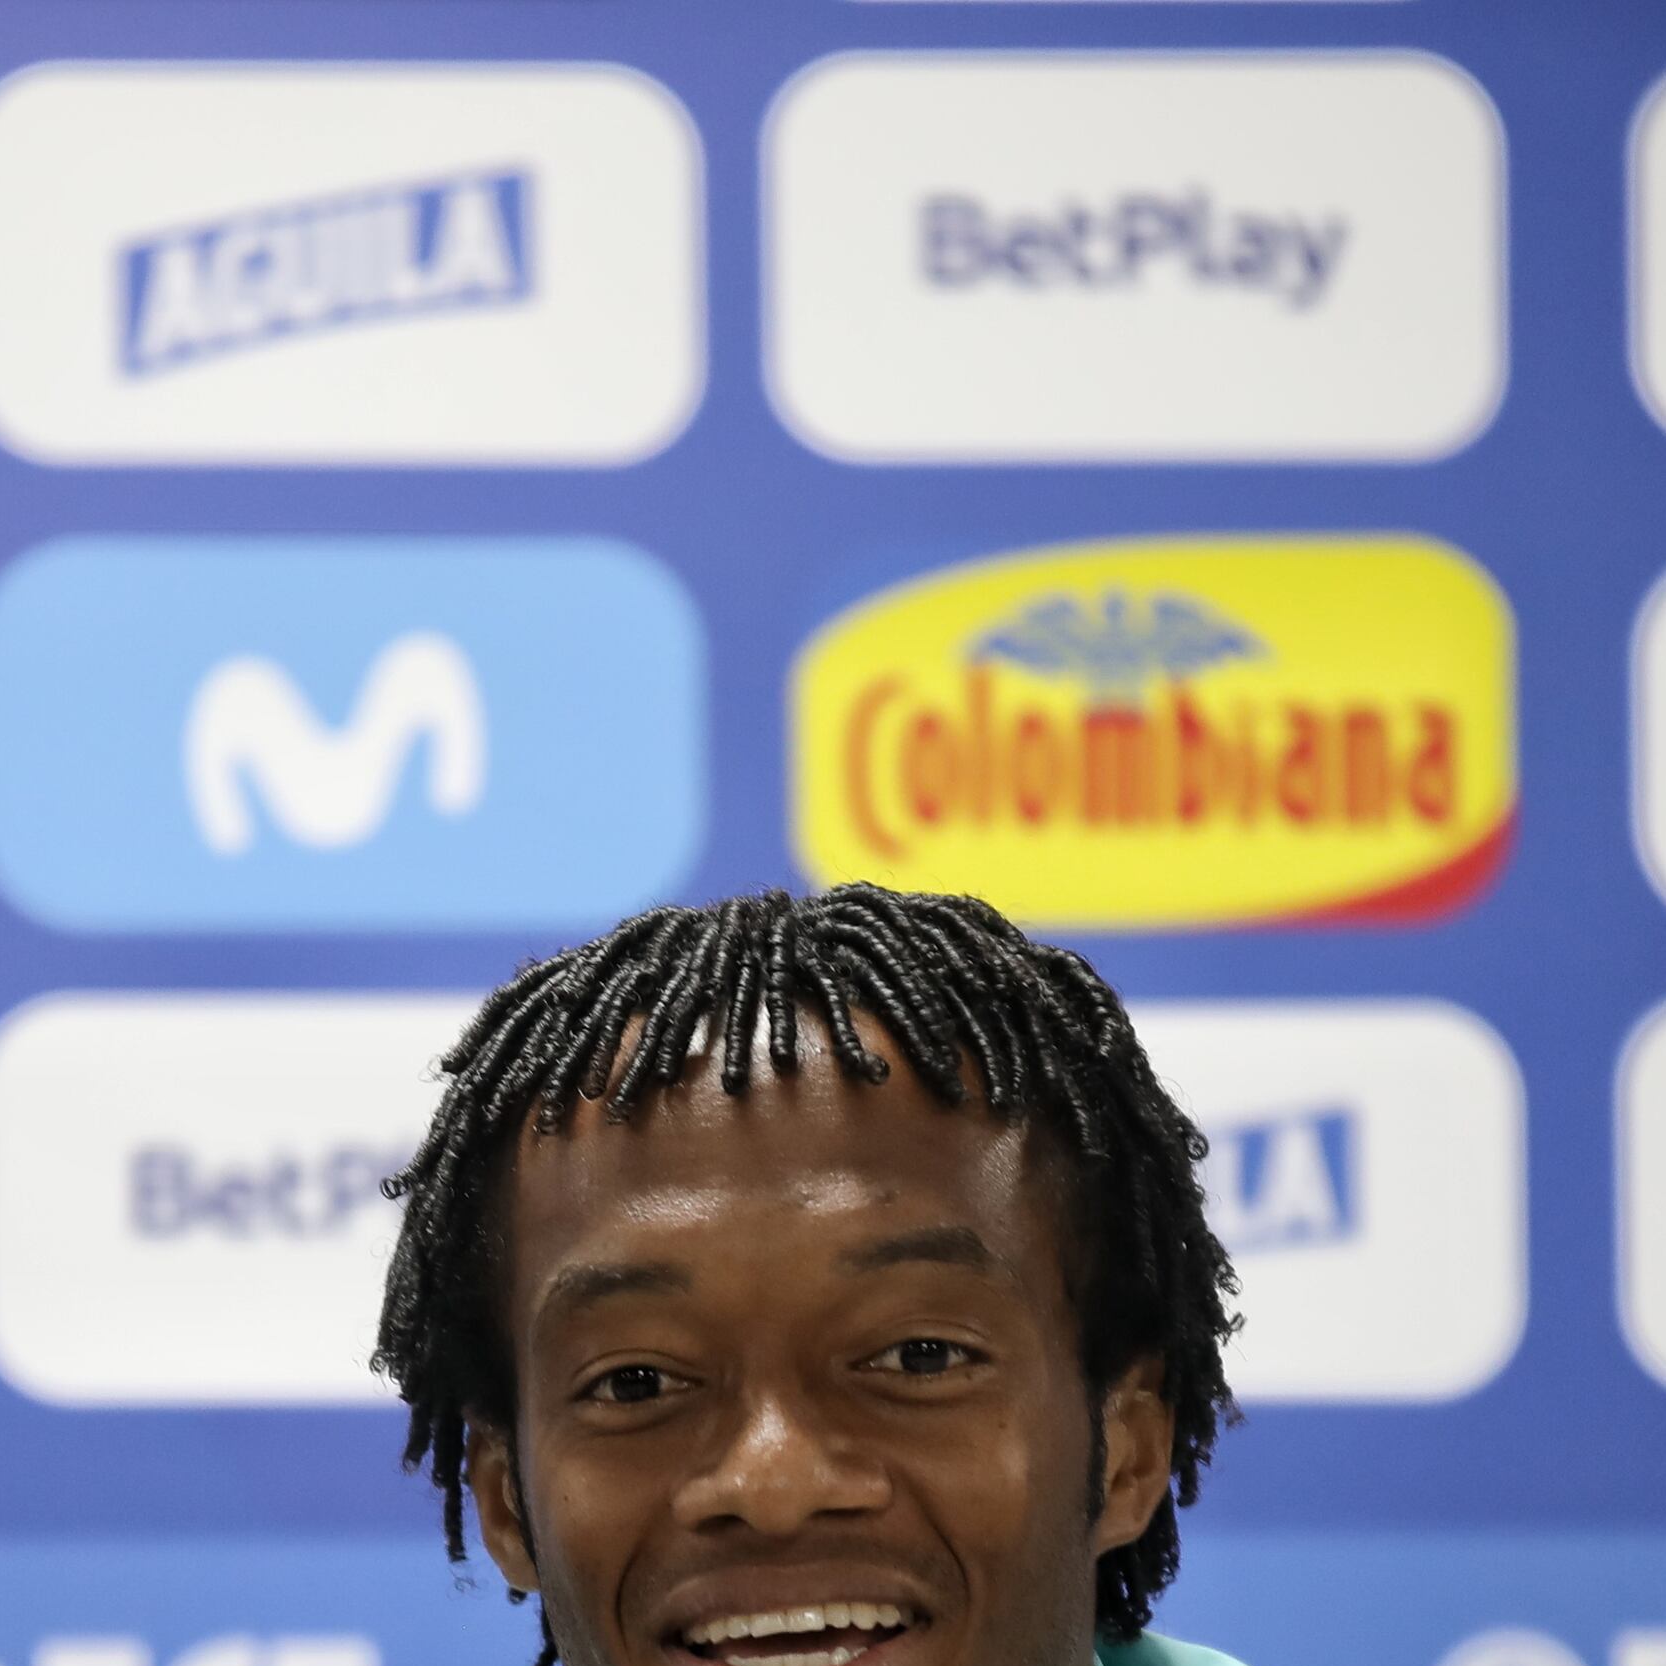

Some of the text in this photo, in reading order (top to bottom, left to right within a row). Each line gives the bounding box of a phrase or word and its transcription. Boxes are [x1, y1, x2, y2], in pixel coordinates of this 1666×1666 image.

[131, 175, 520, 358] AGUILA
[917, 187, 1347, 310] BetPlay
[842, 665, 1461, 868] Colombiana
[128, 1135, 407, 1242] BetP
